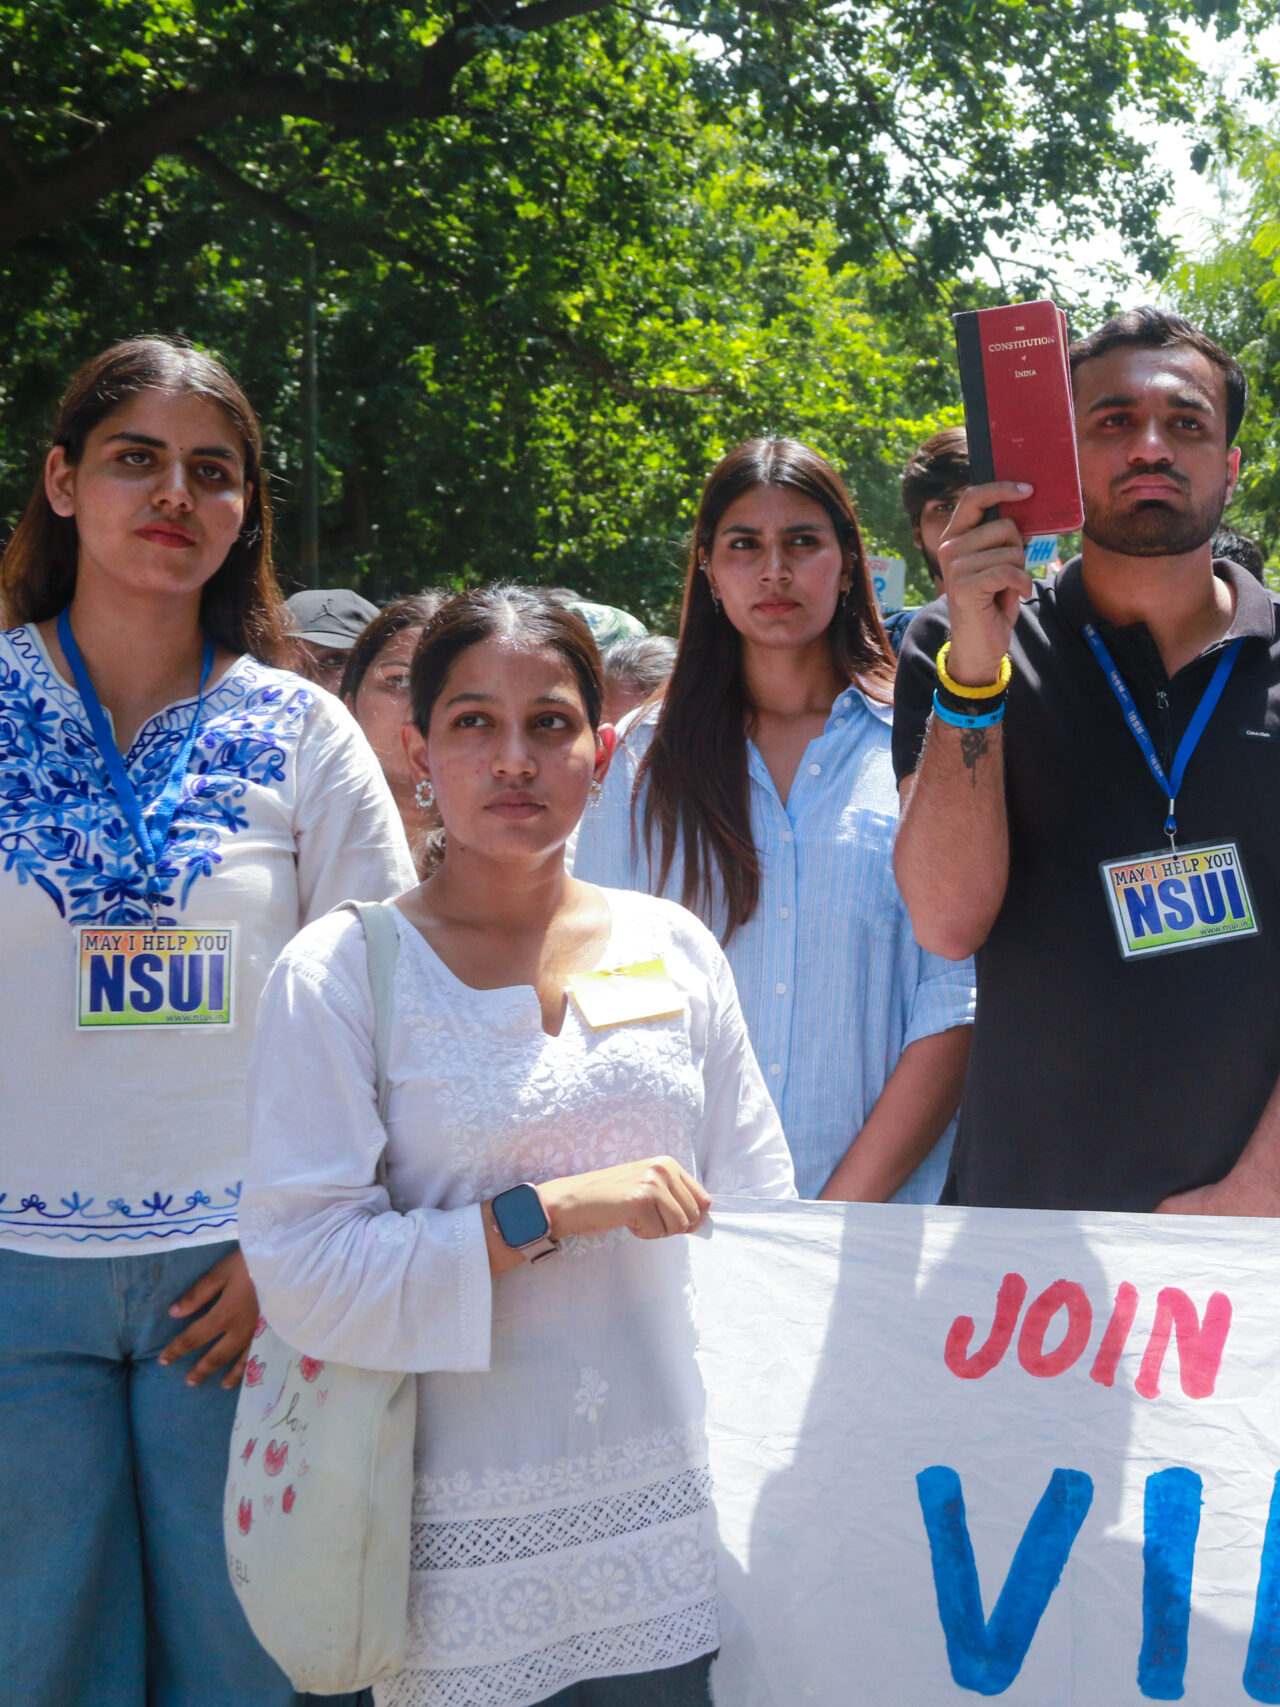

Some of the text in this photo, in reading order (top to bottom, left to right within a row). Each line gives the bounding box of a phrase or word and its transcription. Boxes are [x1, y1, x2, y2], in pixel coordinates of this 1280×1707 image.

[988, 336, 1055, 352] CONSTITUTION
[1014, 369, 1037, 378] INDIA
[1114, 852, 1234, 886] MAY I HELP YOU
[1123, 868, 1246, 938] NSUI
[1200, 920, 1249, 935] www.nsui.in
[85, 935, 228, 951] MAY I HELP YOU
[89, 953, 225, 1013] NSUI
[165, 1013, 224, 1023] www.nsui.in
[944, 1273, 1232, 1400] JOIN
